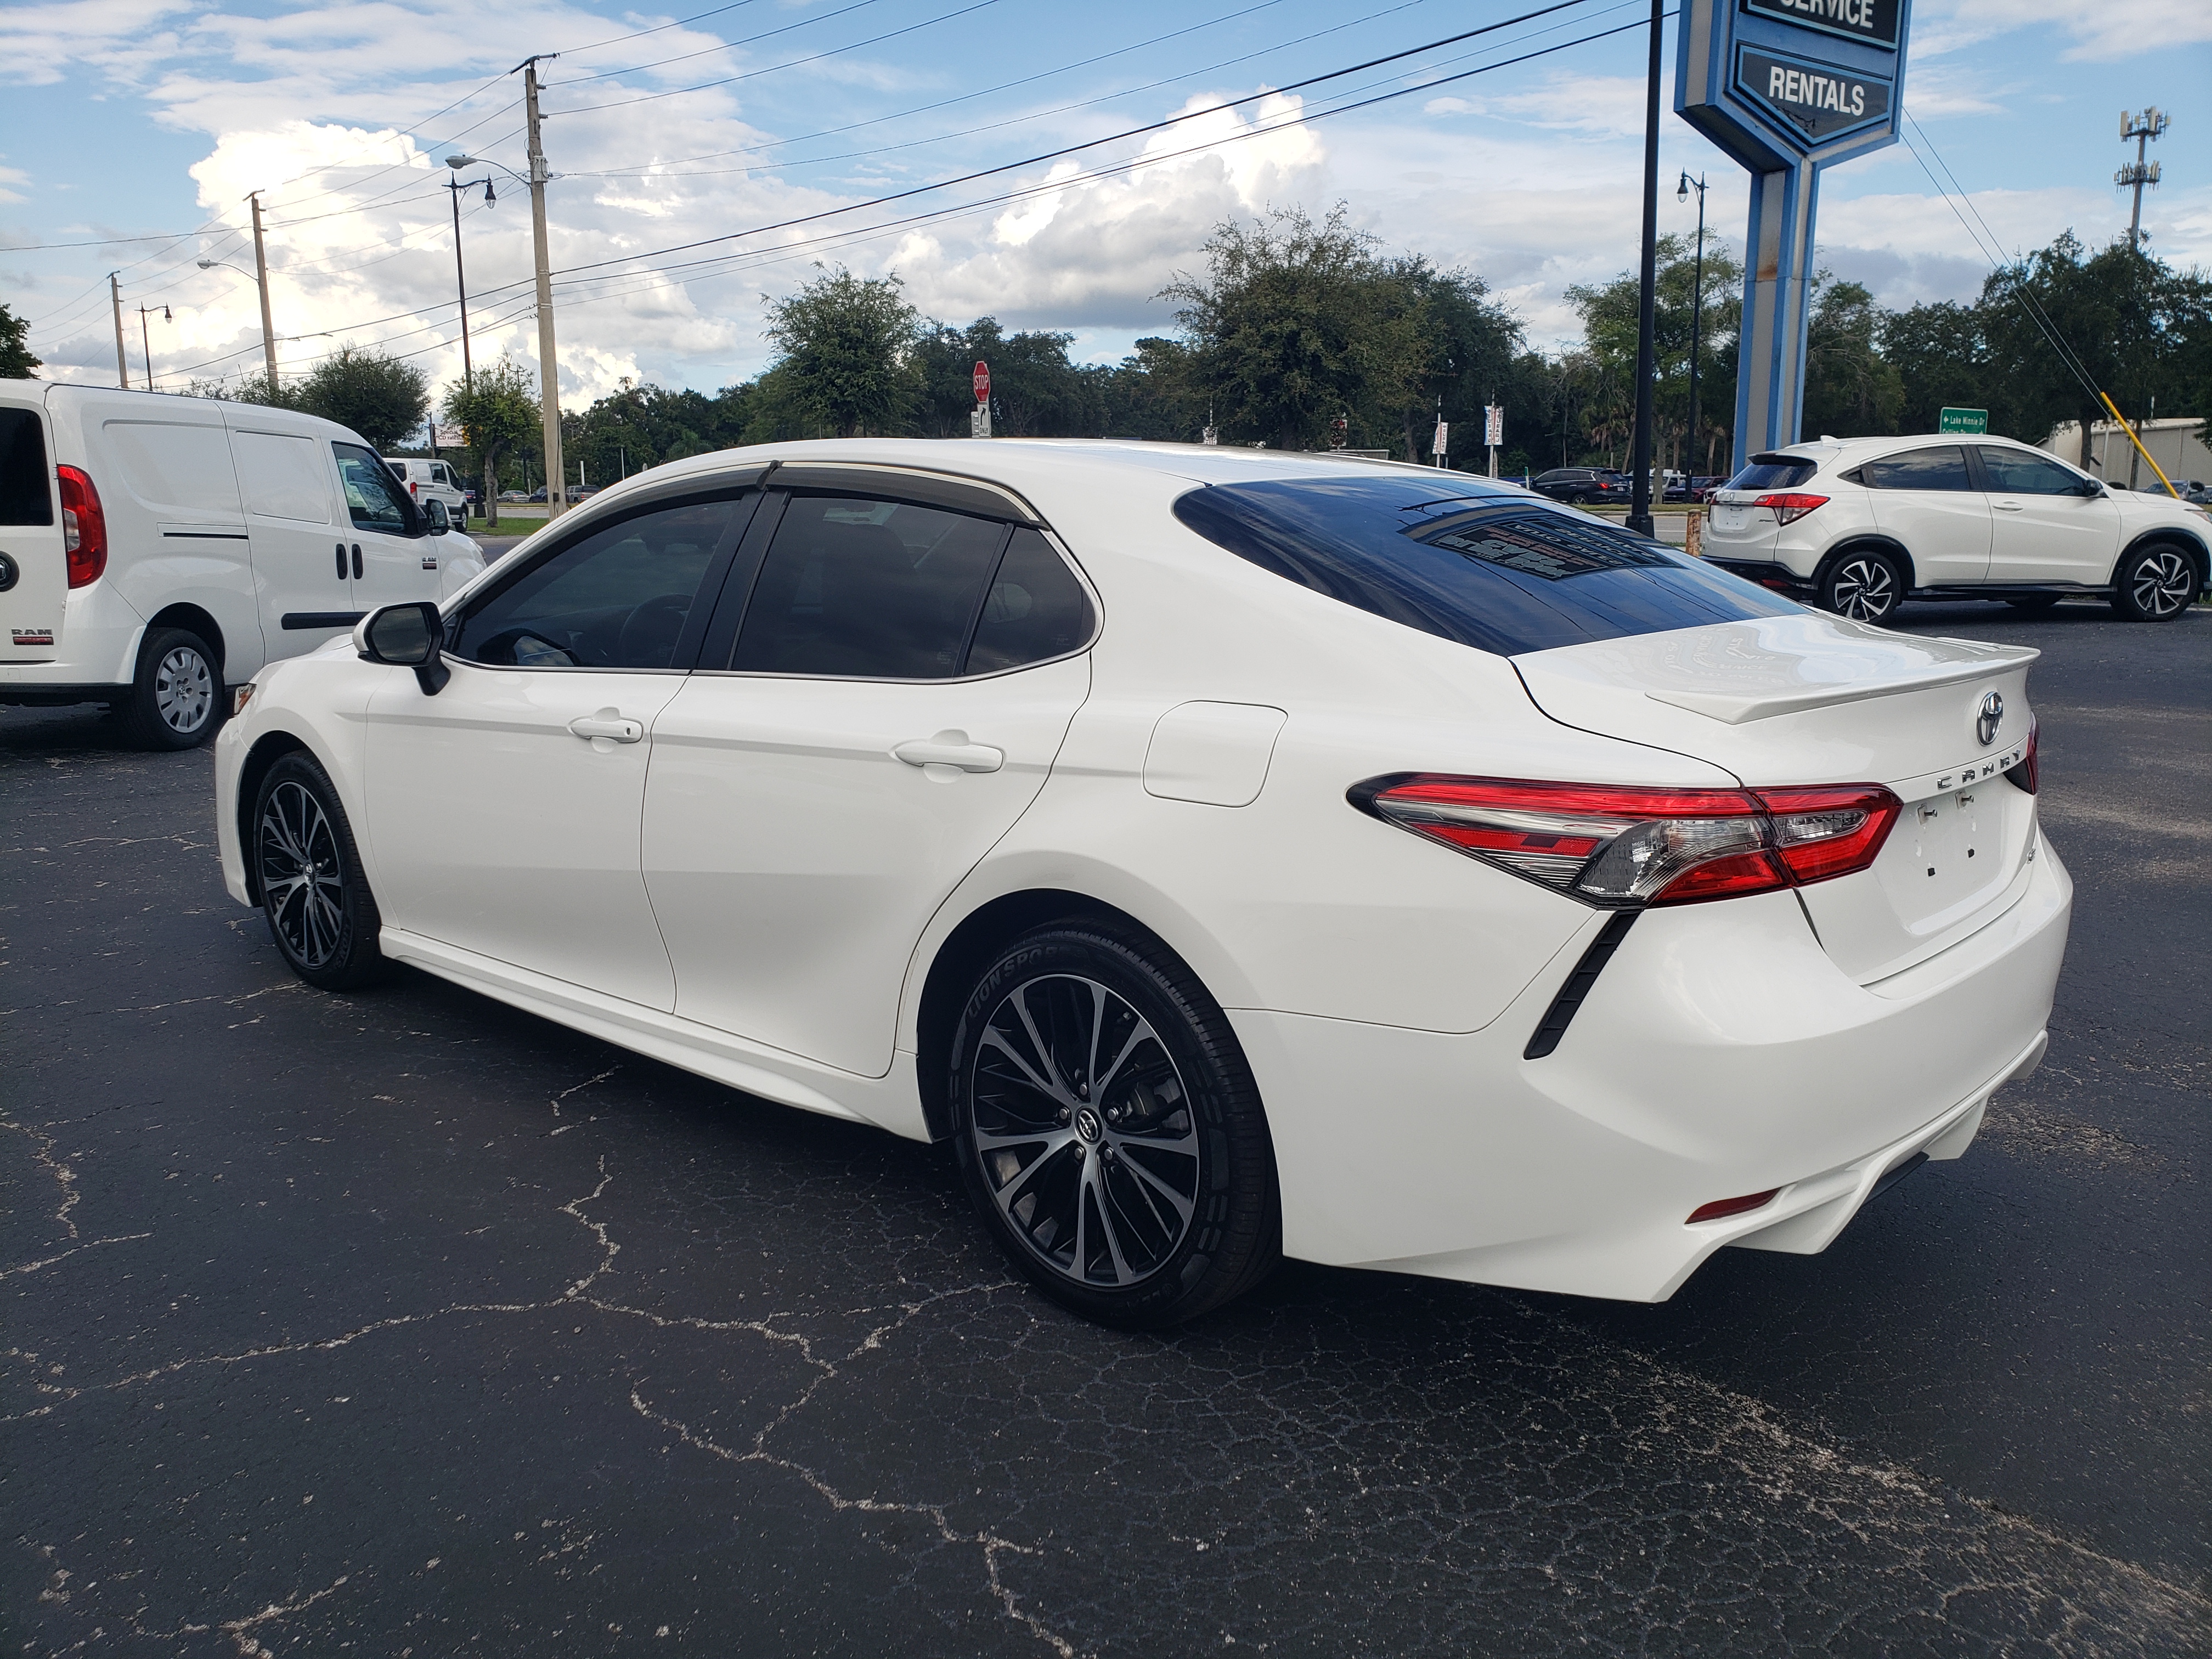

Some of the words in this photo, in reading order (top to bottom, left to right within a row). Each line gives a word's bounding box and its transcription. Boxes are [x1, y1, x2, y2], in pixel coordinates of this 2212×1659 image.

[1781, 0, 1875, 29] RVICE
[1769, 66, 1865, 117] RENTALS
[975, 374, 989, 390] STOP
[1950, 415, 1961, 425] Lake
[1962, 416, 1978, 425] Minnie
[1979, 417, 1985, 426] Dr
[1937, 749, 2021, 790] CAMRY
